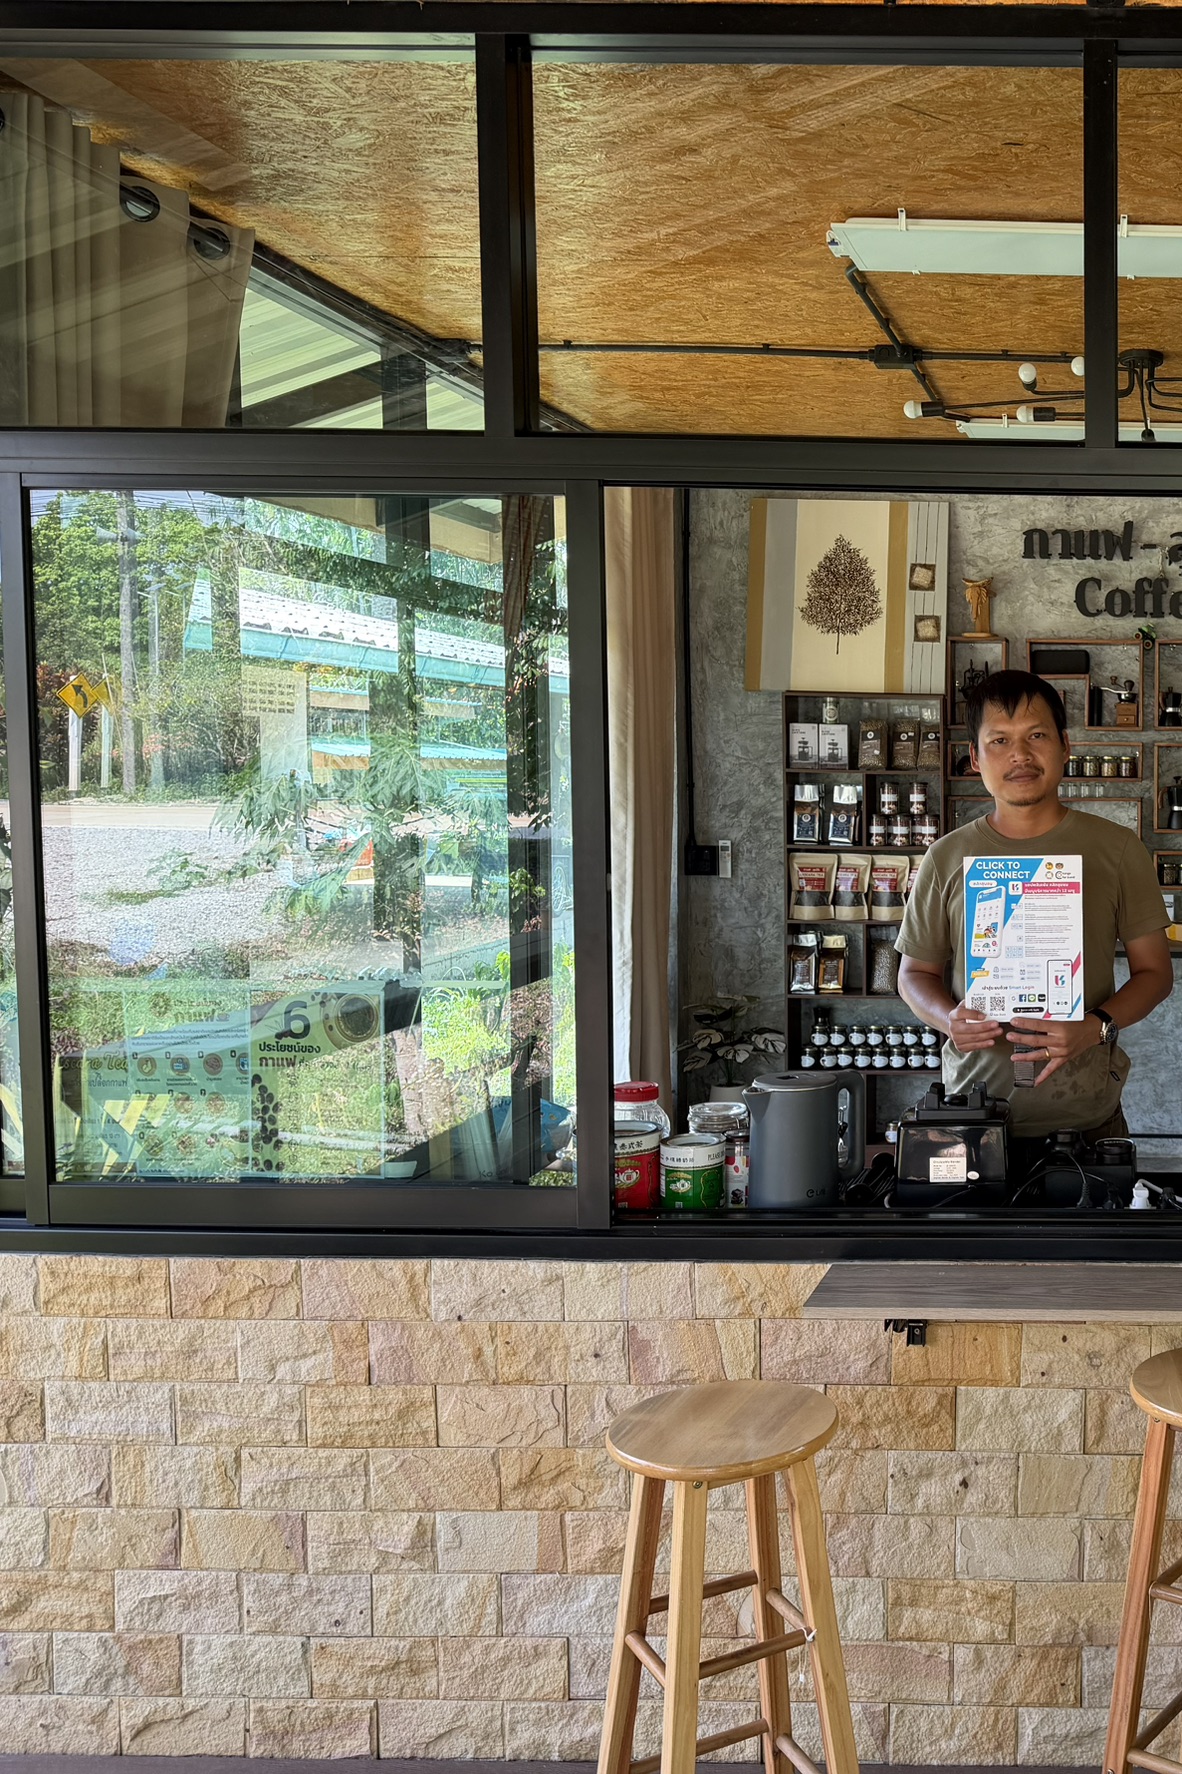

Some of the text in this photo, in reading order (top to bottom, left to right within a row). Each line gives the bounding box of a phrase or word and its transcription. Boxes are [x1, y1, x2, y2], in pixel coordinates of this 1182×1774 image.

[976, 861, 1020, 869] CLICK TO
[983, 871, 1030, 879] CONNECT
[284, 1000, 311, 1039] 6
[258, 1041, 321, 1053] ประโยชน์ของ
[258, 1056, 297, 1068] กาแฟ
